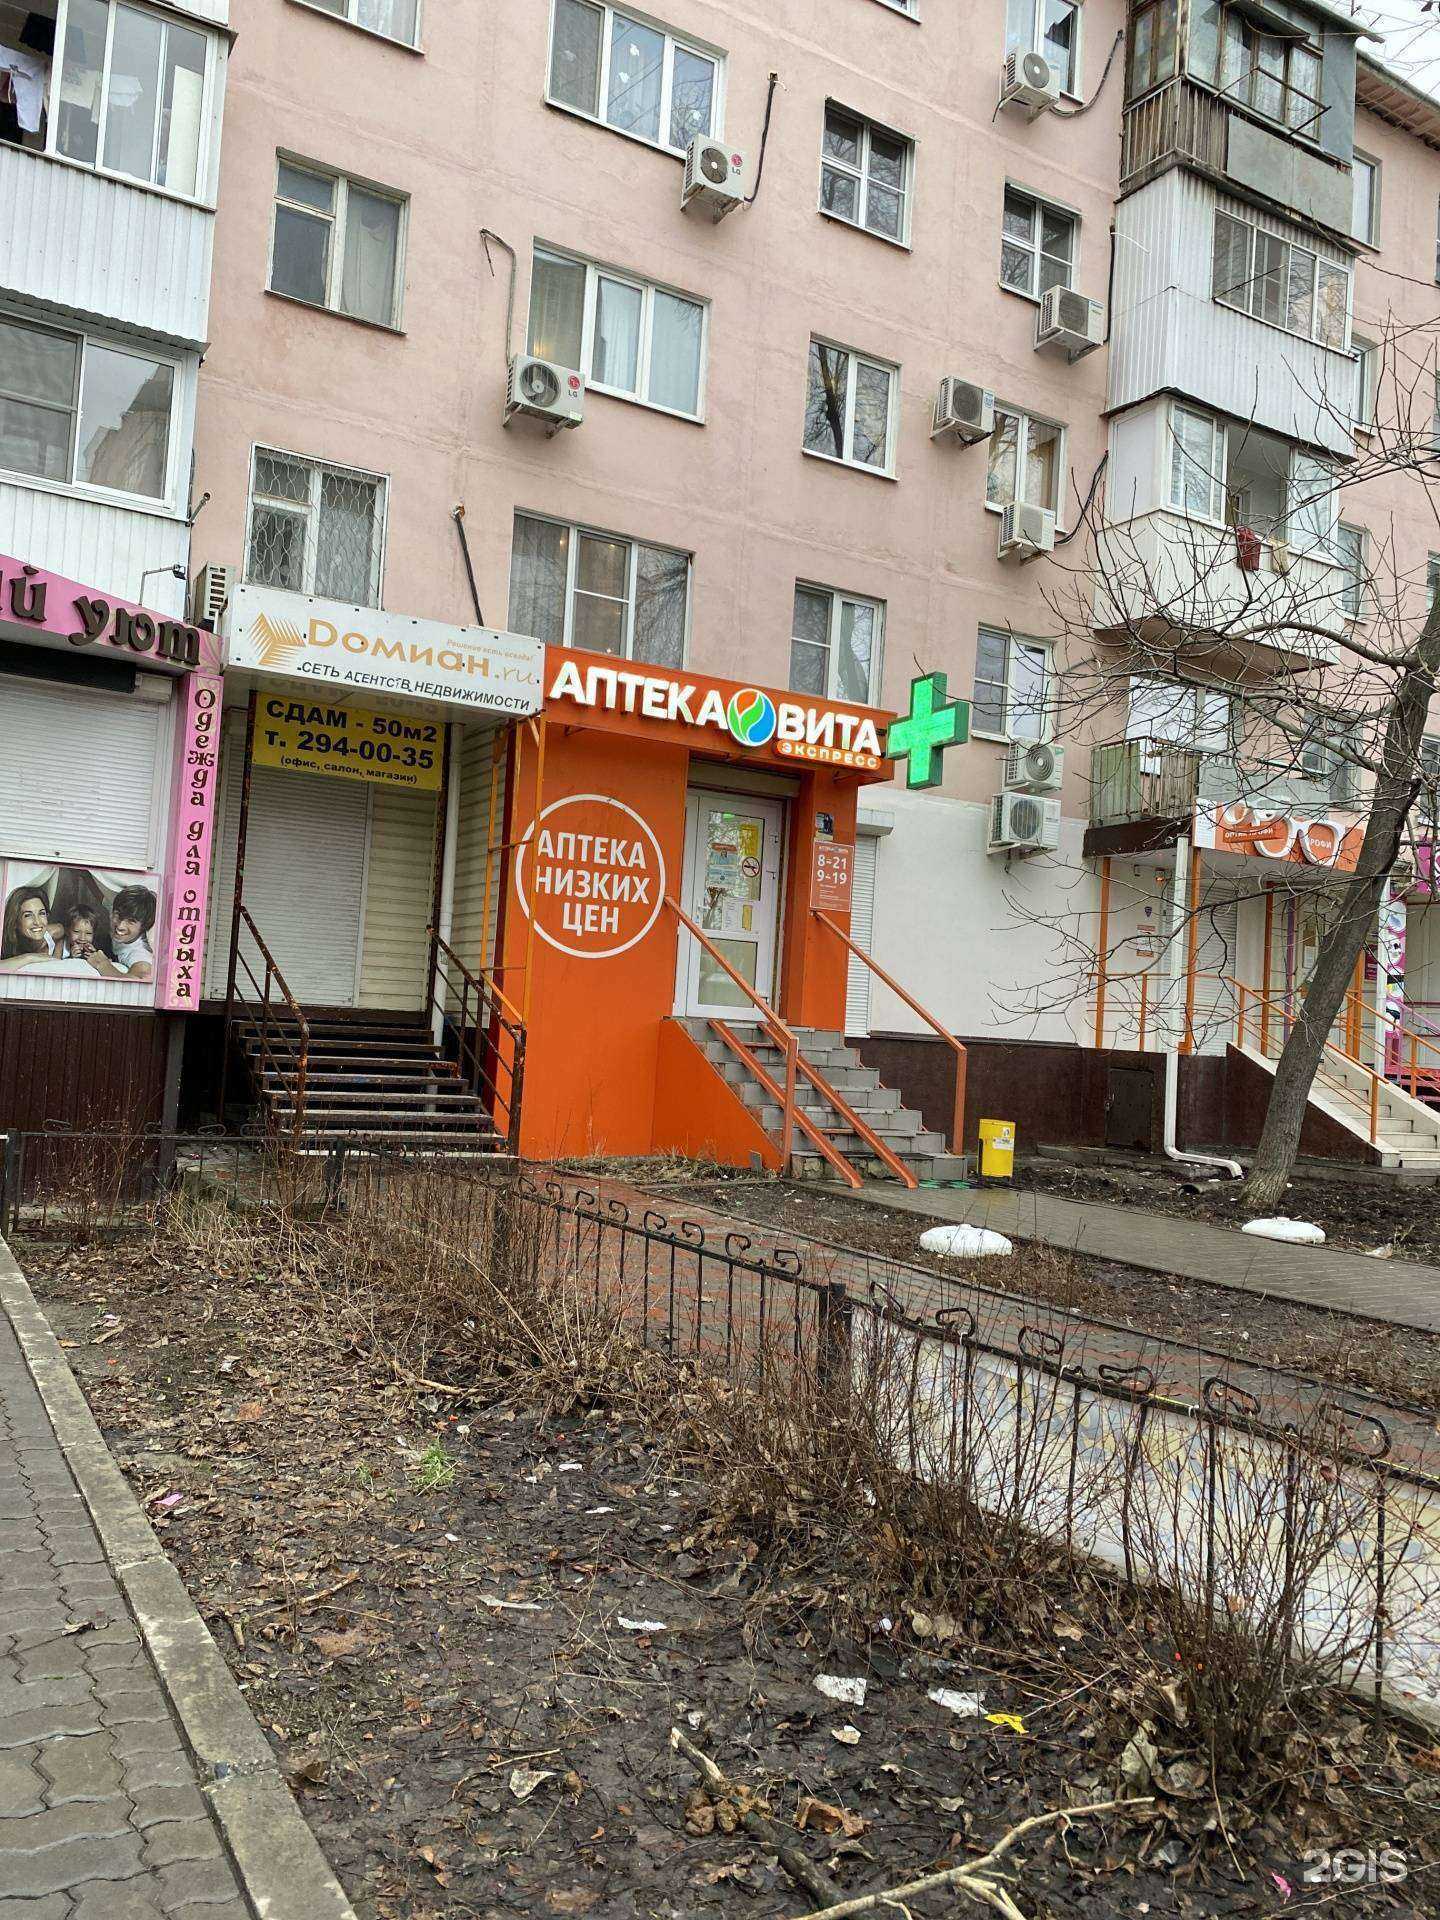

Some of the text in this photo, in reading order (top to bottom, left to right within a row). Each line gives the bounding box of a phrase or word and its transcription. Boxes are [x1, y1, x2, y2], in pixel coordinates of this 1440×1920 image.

[568, 389, 578, 398] LG
[68, 595, 201, 665] уют
[302, 661, 340, 678] СЕТЬ
[415, 682, 530, 711] НЕДВИЖИМОСТИ
[266, 700, 348, 729] СДАМ
[372, 717, 437, 743] 50м2
[549, 660, 882, 757] АПТЕКА ВИТА
[297, 730, 434, 769] 294-00-35
[781, 742, 877, 768] ЭКСПРЕСС
[280, 755, 418, 784] (офис, салон, магазин)
[176, 688, 216, 998] Одежда для отдыха
[538, 829, 647, 870] АПТЕКА
[817, 854, 847, 870] 8-21
[535, 865, 650, 905] НИЗКИХ
[817, 869, 847, 885] 9-19
[562, 902, 619, 937] ЦЕН
